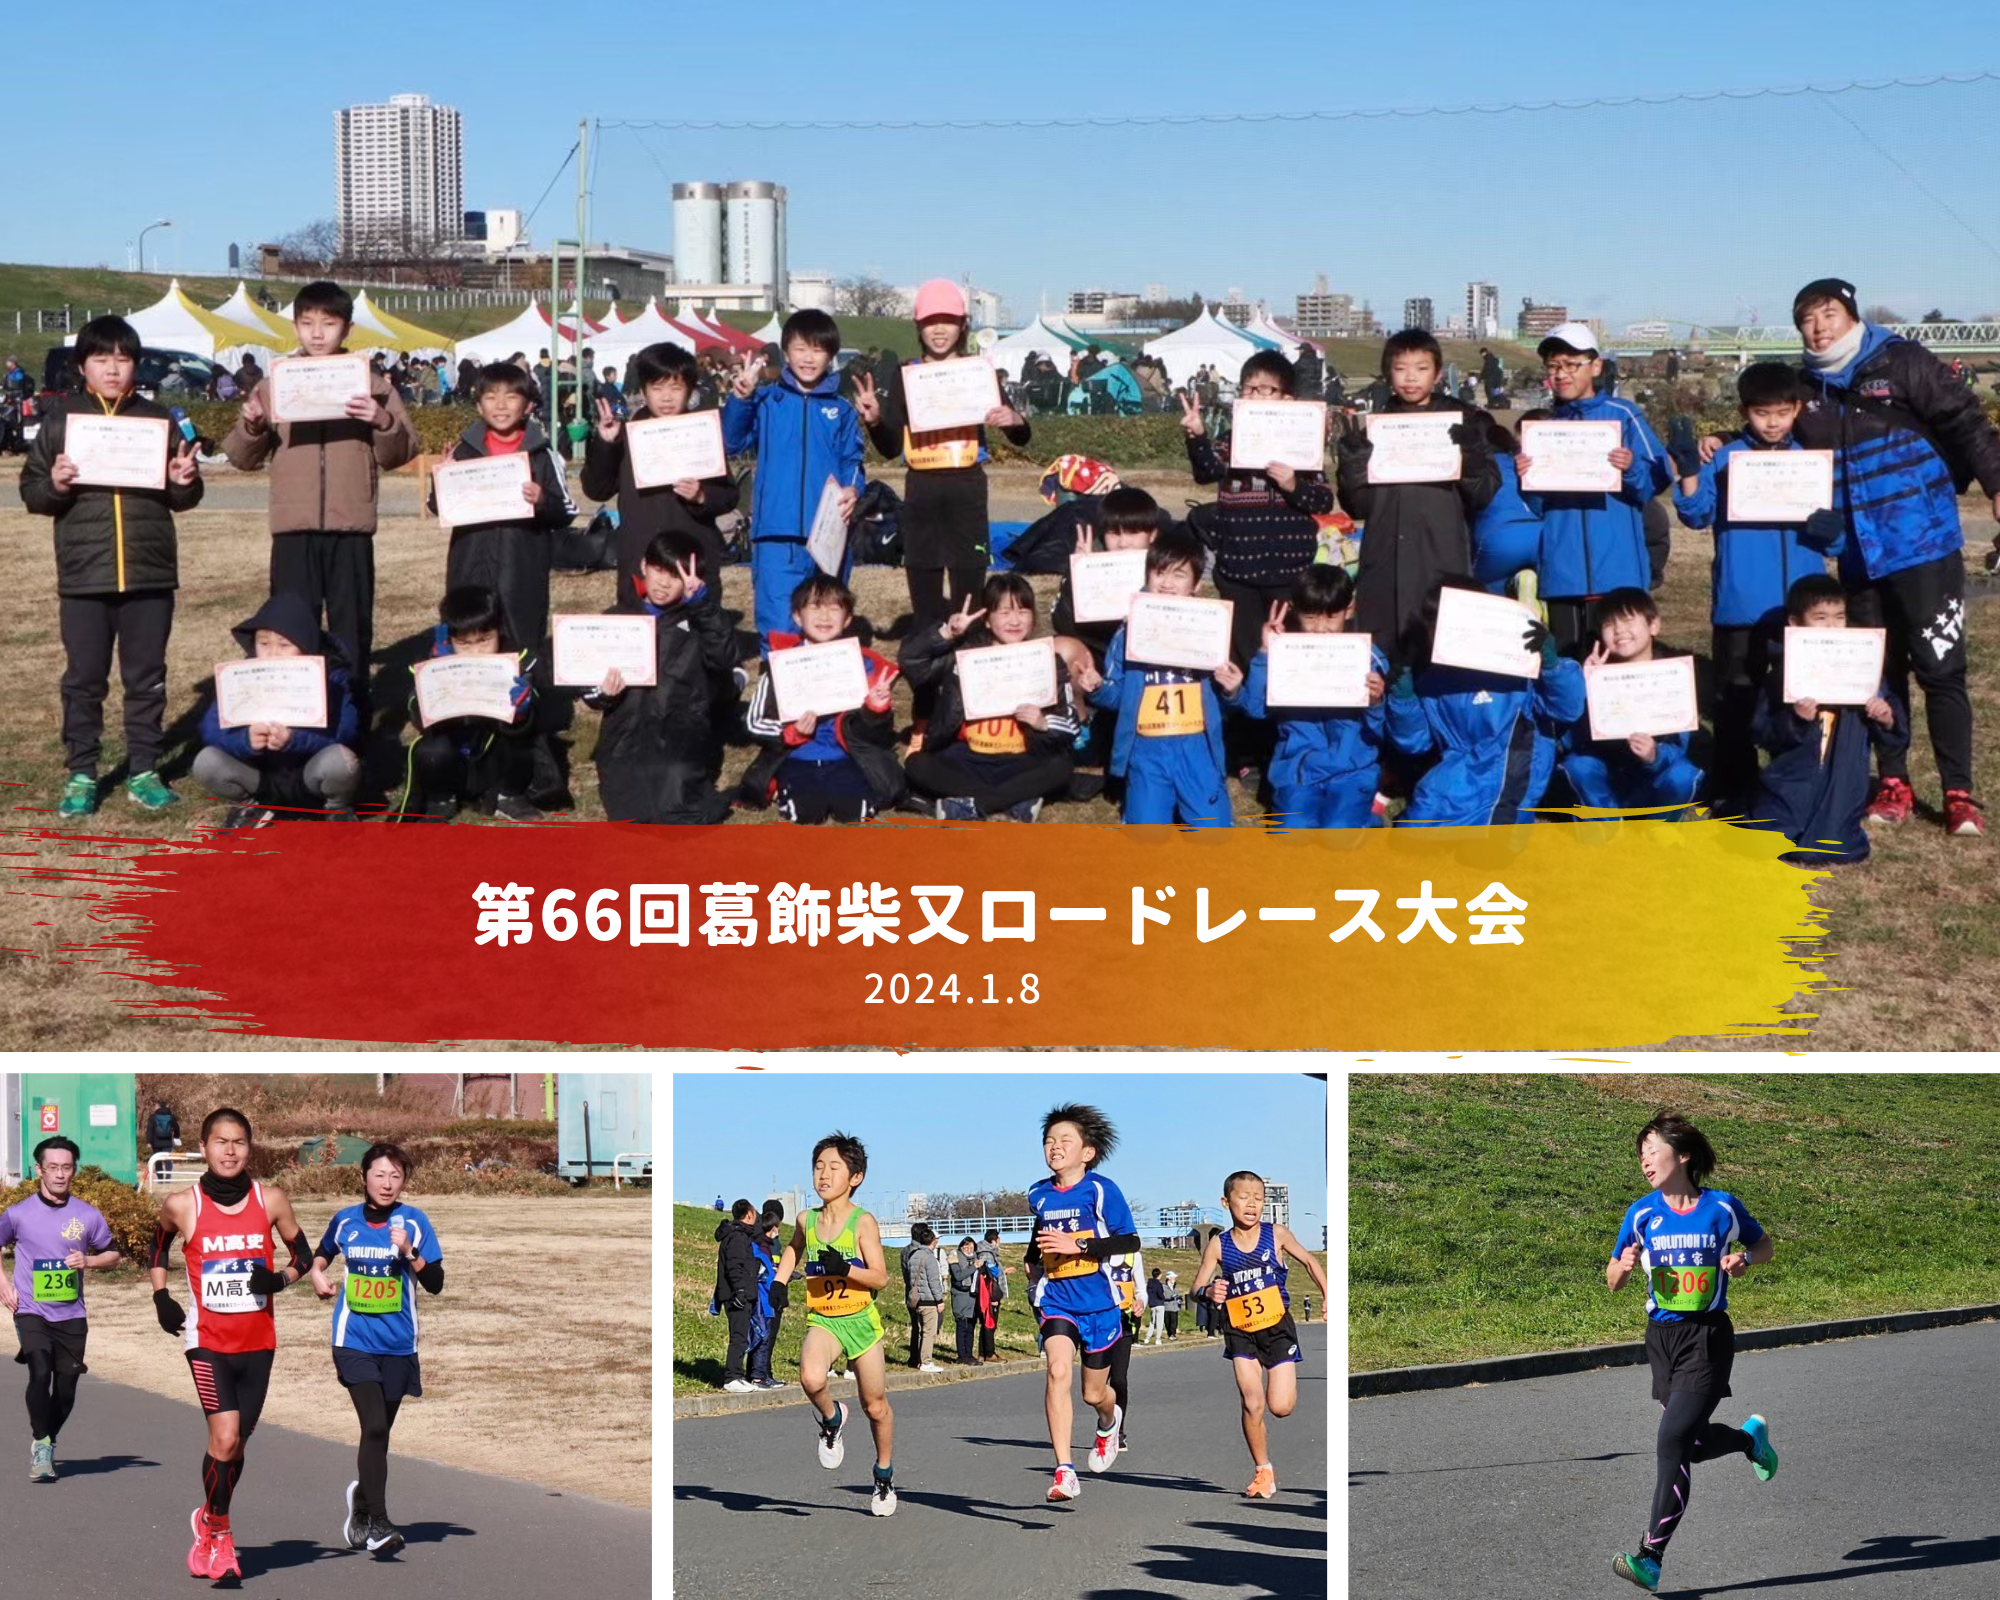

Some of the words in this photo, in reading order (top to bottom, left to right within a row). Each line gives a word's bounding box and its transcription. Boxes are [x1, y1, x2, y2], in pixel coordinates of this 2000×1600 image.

[1156, 689, 1186, 716] 41
[202, 1234, 264, 1253] M高史
[44, 1274, 75, 1290] 236
[354, 1279, 397, 1299] 1205
[824, 1279, 849, 1300] 92
[1657, 1271, 1709, 1294] 1206
[1242, 1296, 1264, 1318] 53
